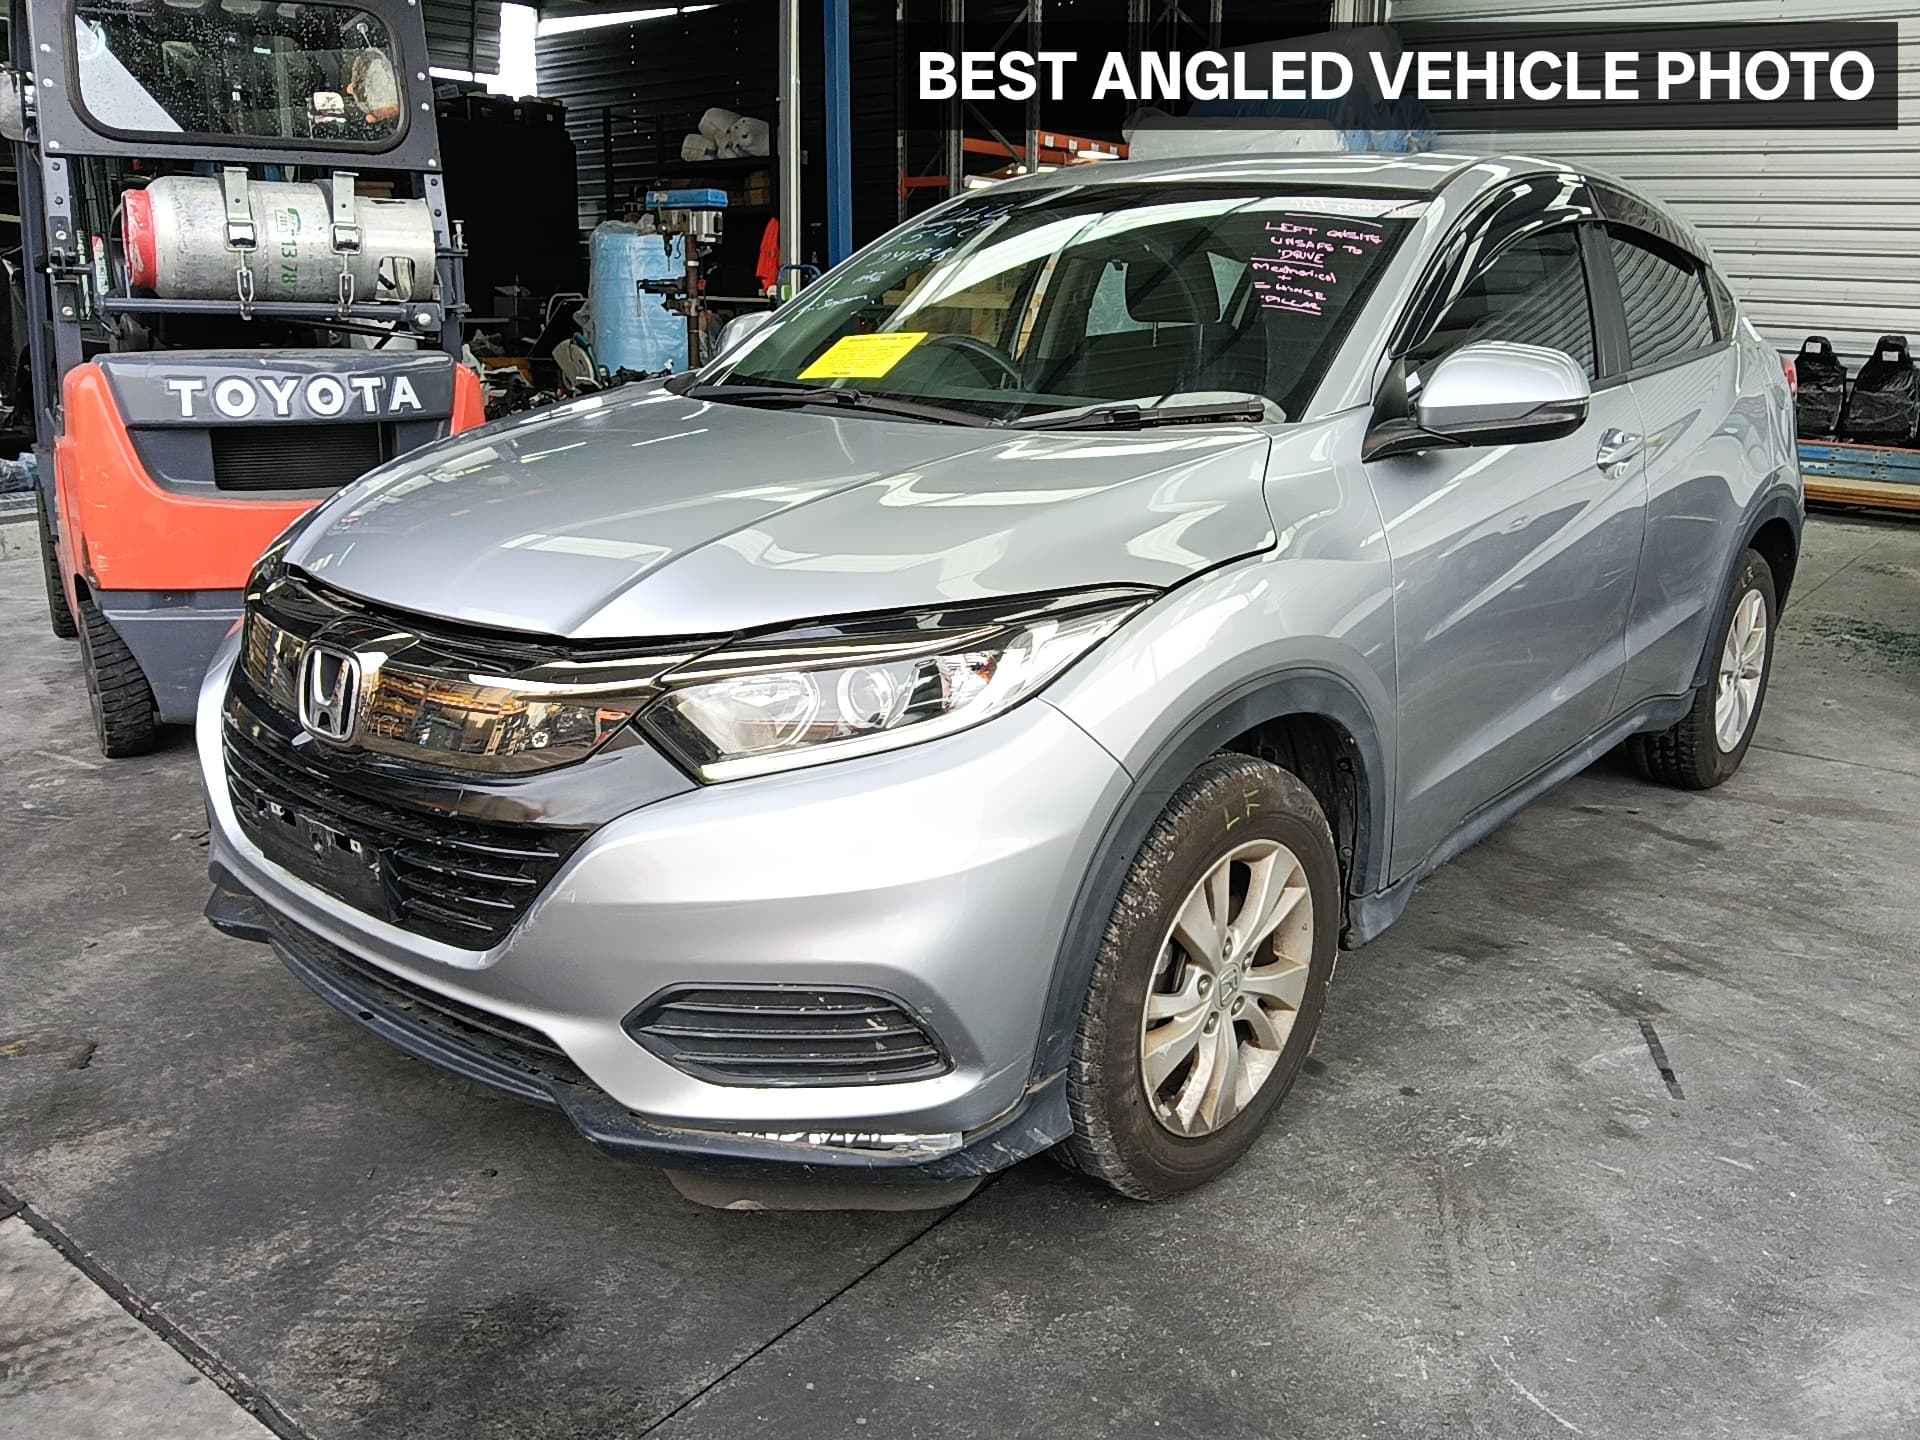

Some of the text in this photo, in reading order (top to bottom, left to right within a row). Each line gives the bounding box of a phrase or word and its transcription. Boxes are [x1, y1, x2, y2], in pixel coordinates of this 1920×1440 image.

[1265, 221, 1318, 235] LEFT
[281, 240, 298, 258] 13
[1270, 236, 1363, 255] UNSAFE TO
[281, 264, 297, 283] 78
[168, 376, 423, 417] TOYOTA
